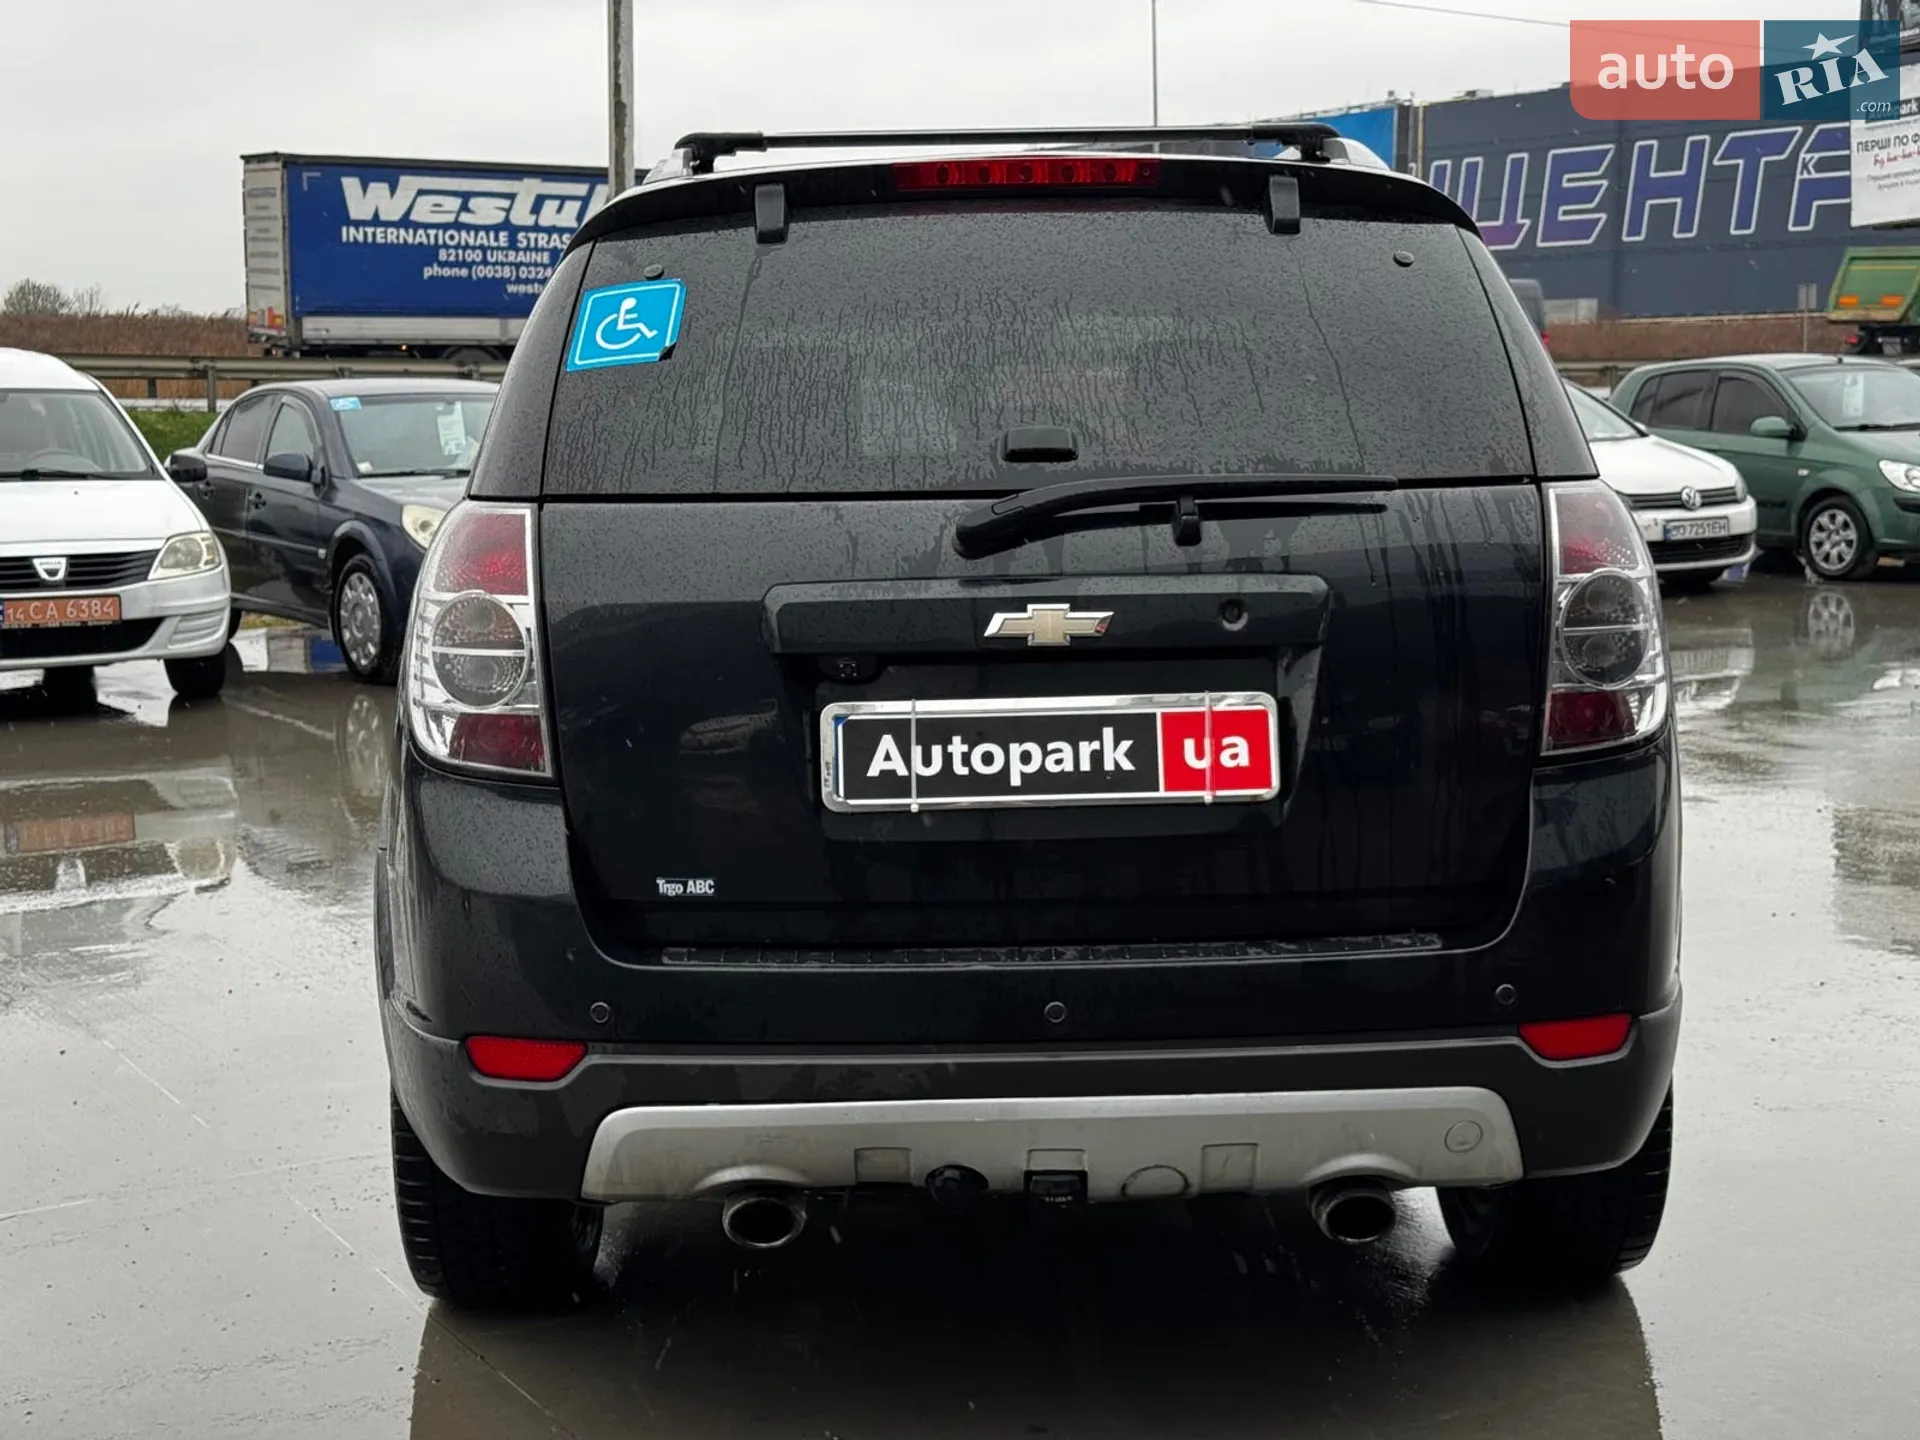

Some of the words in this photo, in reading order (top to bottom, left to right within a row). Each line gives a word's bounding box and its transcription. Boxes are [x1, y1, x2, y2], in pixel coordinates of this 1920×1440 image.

[341, 226, 509, 248] INTERNATIONALE
[438, 248, 482, 263] 82100
[487, 250, 550, 265] UKRAINE
[423, 263, 469, 280] phone
[471, 265, 517, 281] (0038)
[66, 599, 114, 619] 6384
[866, 726, 1136, 787] Autopark
[1182, 734, 1251, 770] ua
[686, 879, 715, 894] ABC
